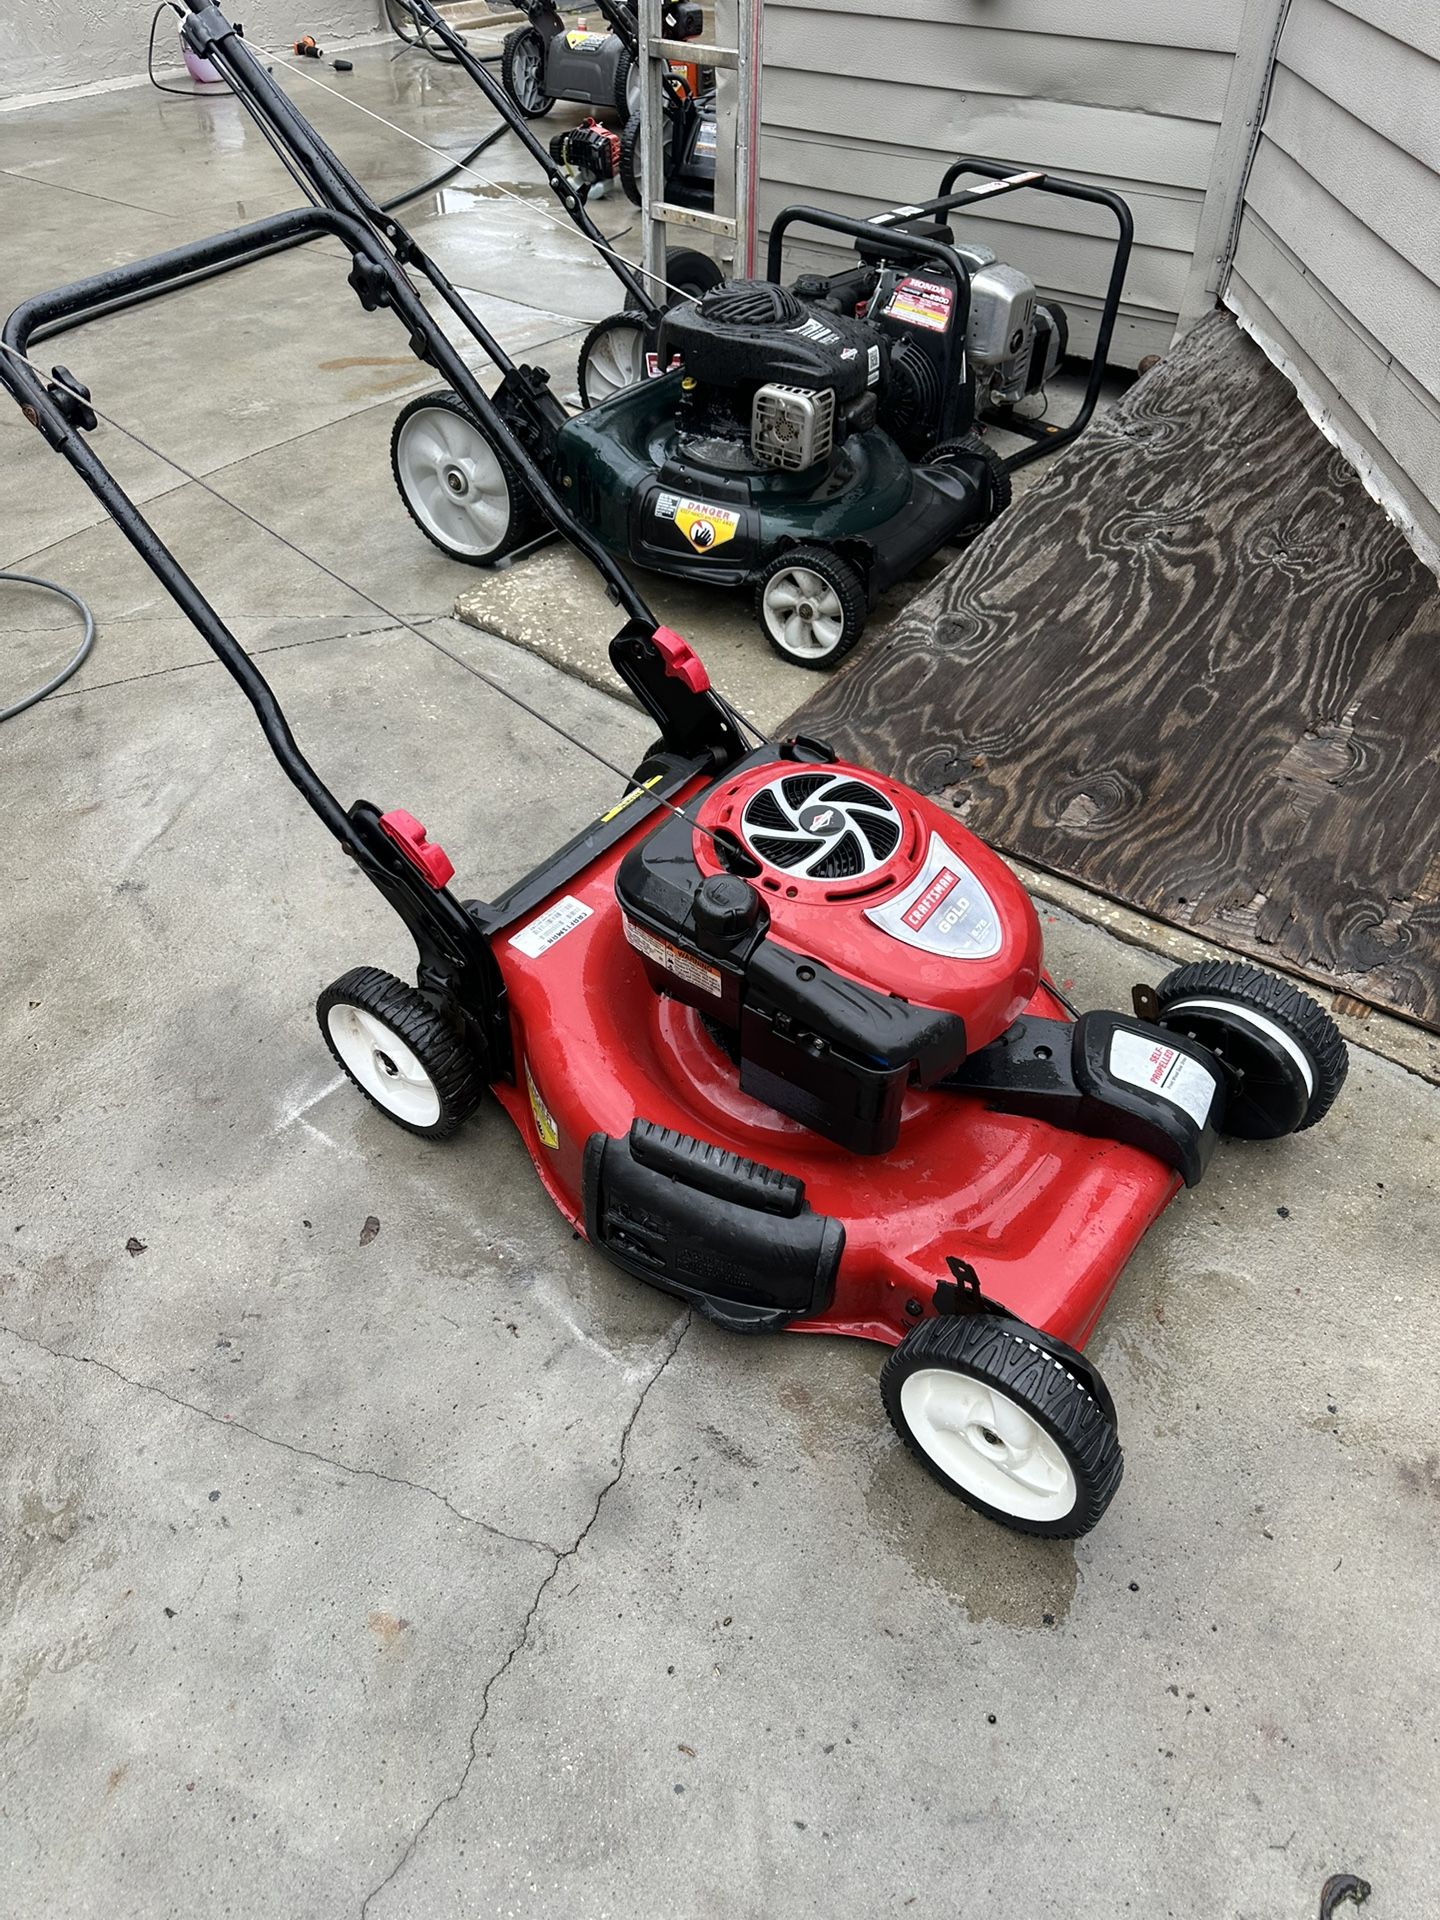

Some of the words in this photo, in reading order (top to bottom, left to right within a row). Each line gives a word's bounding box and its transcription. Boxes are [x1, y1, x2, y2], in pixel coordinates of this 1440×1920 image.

[909, 278, 946, 295] HONDA
[687, 502, 731, 520] DANGER
[908, 871, 955, 925] CRAFTSMAN
[547, 912, 588, 944] CRAFTSMAN
[938, 897, 970, 934] GOLD
[677, 950, 713, 973] WARNING
[1150, 1049, 1174, 1085] PROPELLED
